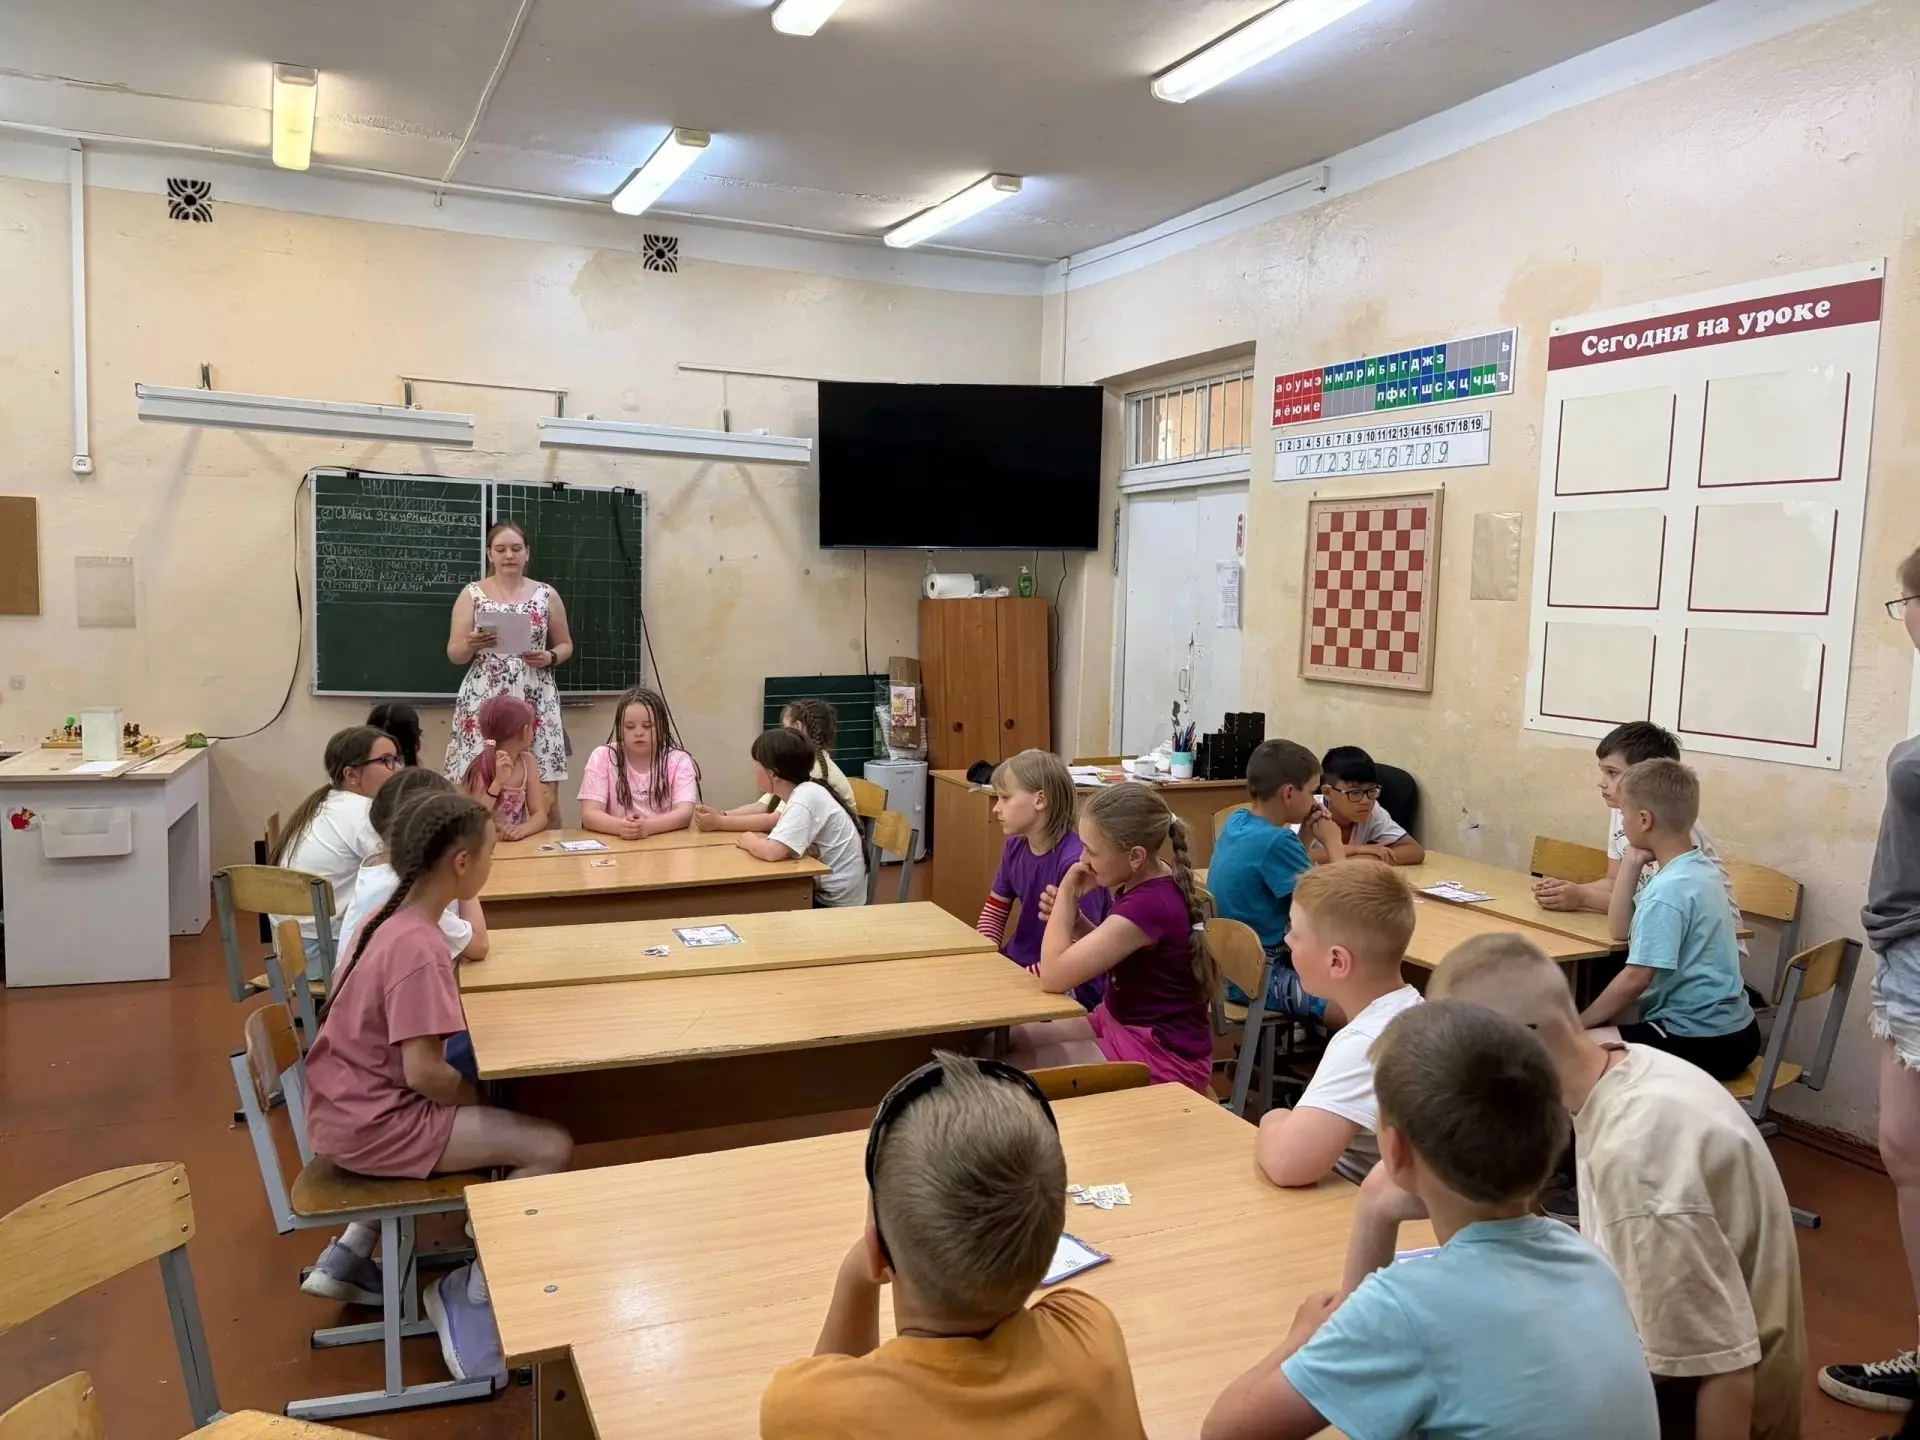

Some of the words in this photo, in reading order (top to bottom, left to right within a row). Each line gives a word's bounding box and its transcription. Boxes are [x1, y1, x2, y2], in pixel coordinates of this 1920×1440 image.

[1582, 325, 1689, 356] Сегодня
[1696, 317, 1730, 338] на
[1738, 300, 1831, 336] уроке
[1367, 431, 1375, 441] 10
[1377, 430, 1386, 440] 11
[1388, 428, 1397, 439] 12
[1399, 427, 1408, 438] 13
[1411, 426, 1419, 436] 14
[1422, 424, 1431, 435] 15
[1434, 423, 1444, 434] 16
[1446, 422, 1456, 432] 17
[1458, 420, 1468, 431] 18
[1471, 419, 1481, 430] 19
